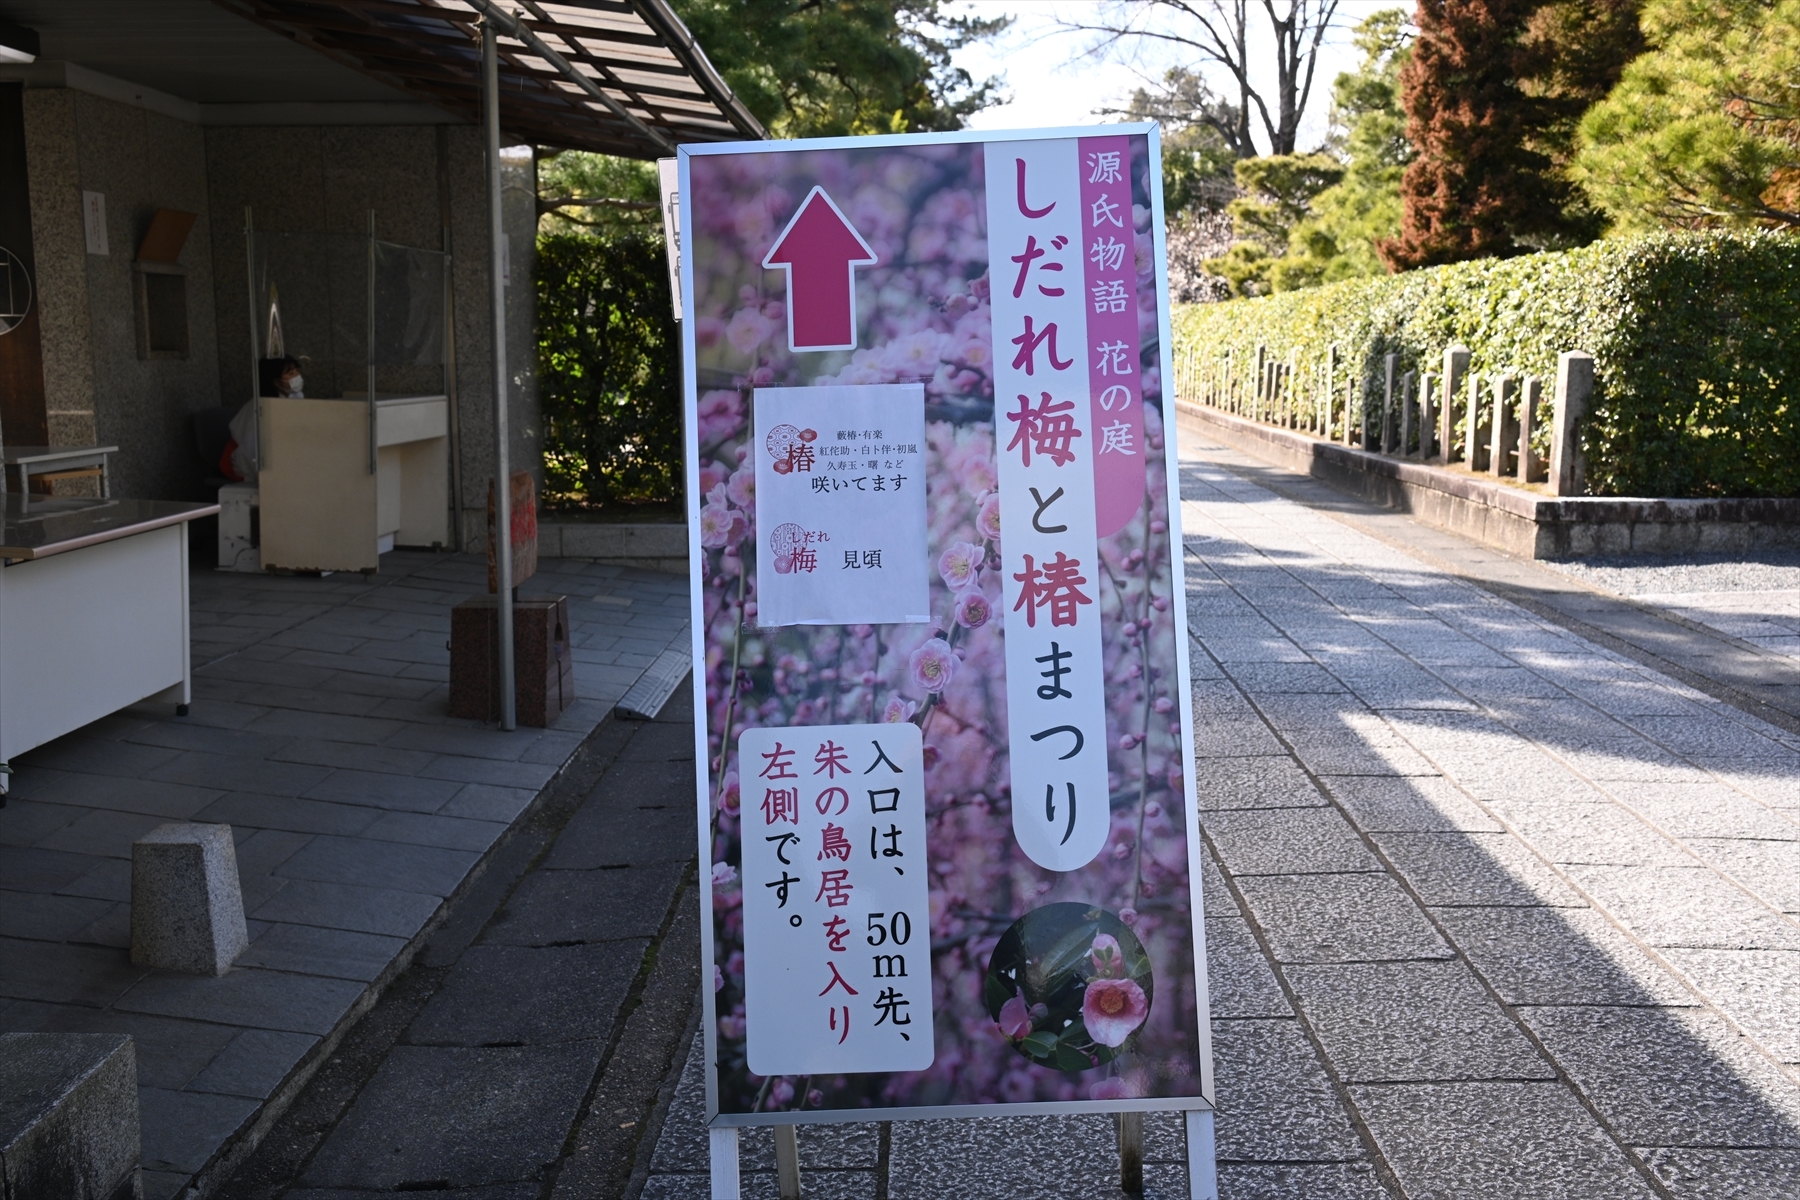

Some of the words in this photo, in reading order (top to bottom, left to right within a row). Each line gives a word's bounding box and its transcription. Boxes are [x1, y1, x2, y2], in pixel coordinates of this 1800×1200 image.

[1086, 151, 1129, 314] 源氏物語
[1096, 340, 1137, 456] 花の庭
[785, 443, 816, 474] 椿
[884, 459, 904, 470] など
[811, 474, 908, 494] 咲いてます
[1006, 157, 1092, 846] しだれ梅と椿まつり
[791, 530, 831, 543] しだれ
[790, 546, 818, 574] 梅
[841, 549, 882, 570] 見頃
[758, 742, 803, 928] 左側です。
[813, 740, 859, 1045] 朱の鳥居を入り
